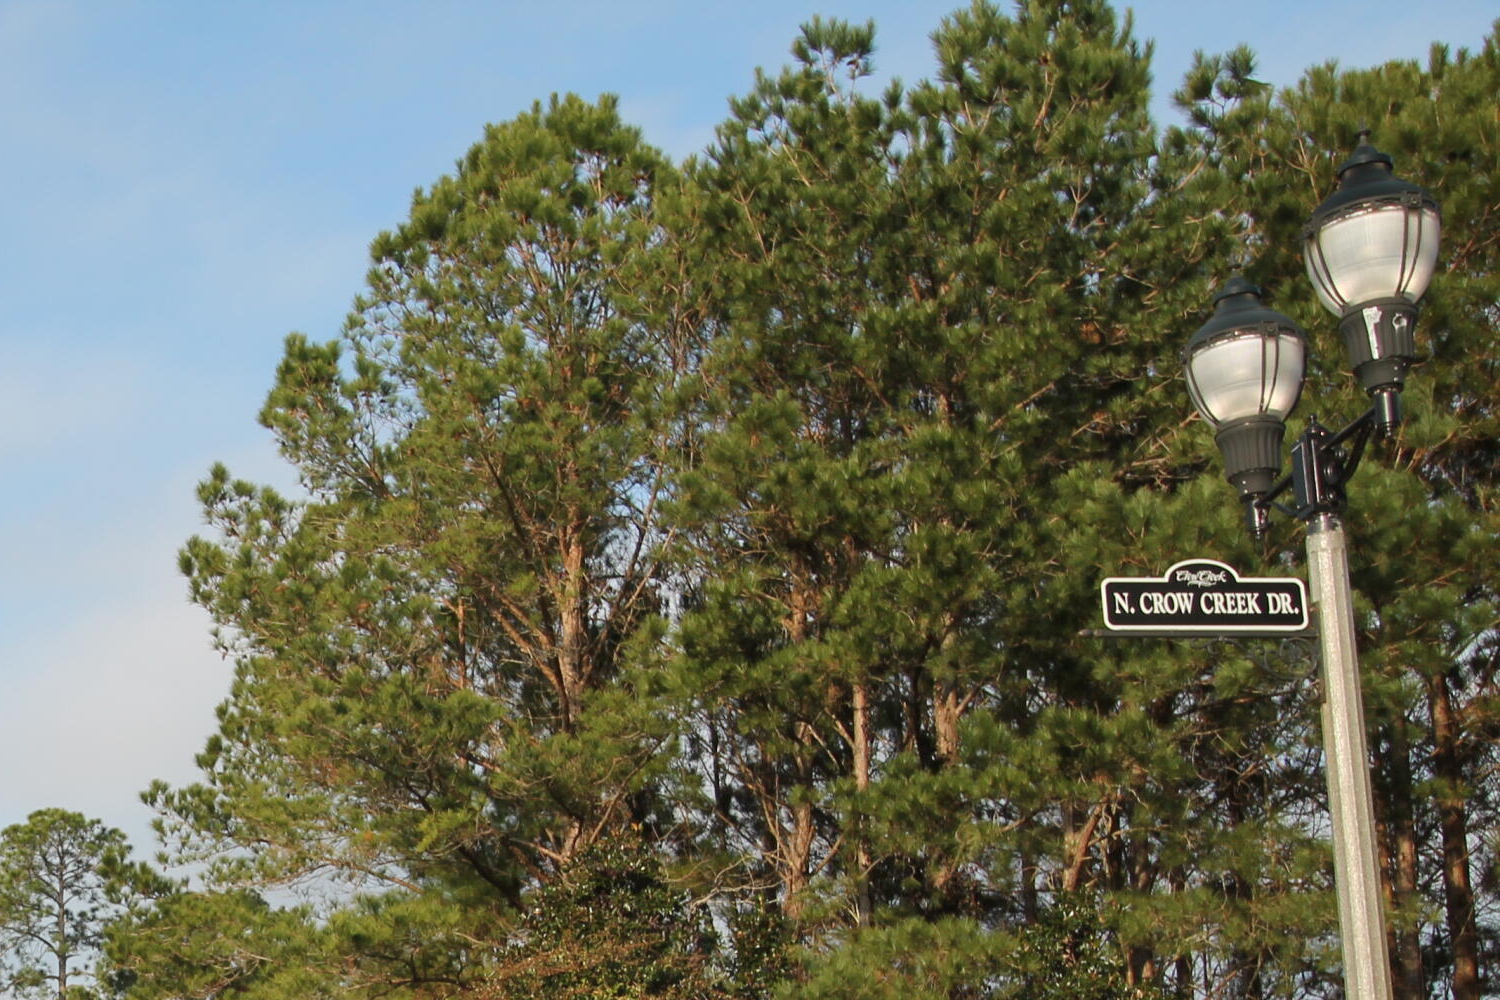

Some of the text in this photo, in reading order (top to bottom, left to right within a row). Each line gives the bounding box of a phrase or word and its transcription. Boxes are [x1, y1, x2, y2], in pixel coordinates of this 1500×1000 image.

[1113, 592, 1300, 615] N. CROW CREEK DR.
